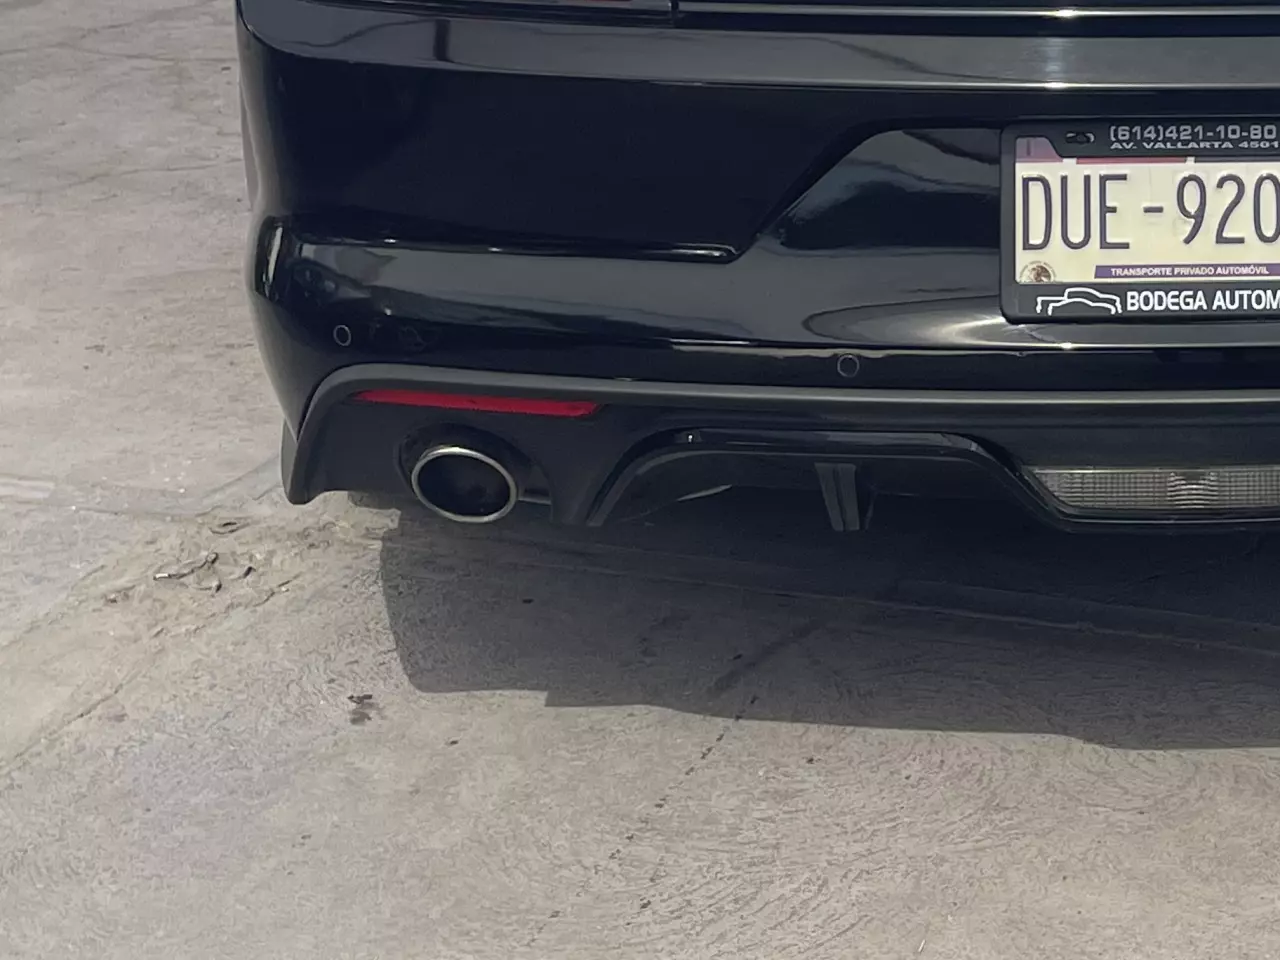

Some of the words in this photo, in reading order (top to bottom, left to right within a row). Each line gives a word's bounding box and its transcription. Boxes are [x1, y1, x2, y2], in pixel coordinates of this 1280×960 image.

[1109, 124, 1277, 141] (614)421-10-80
[1110, 141, 1137, 150] AV.
[1148, 141, 1232, 150] VALLARTA
[1110, 266, 1173, 277] TRANSPORTE
[1173, 266, 1215, 276] PRIVADO
[1126, 290, 1208, 311] BODEGA
